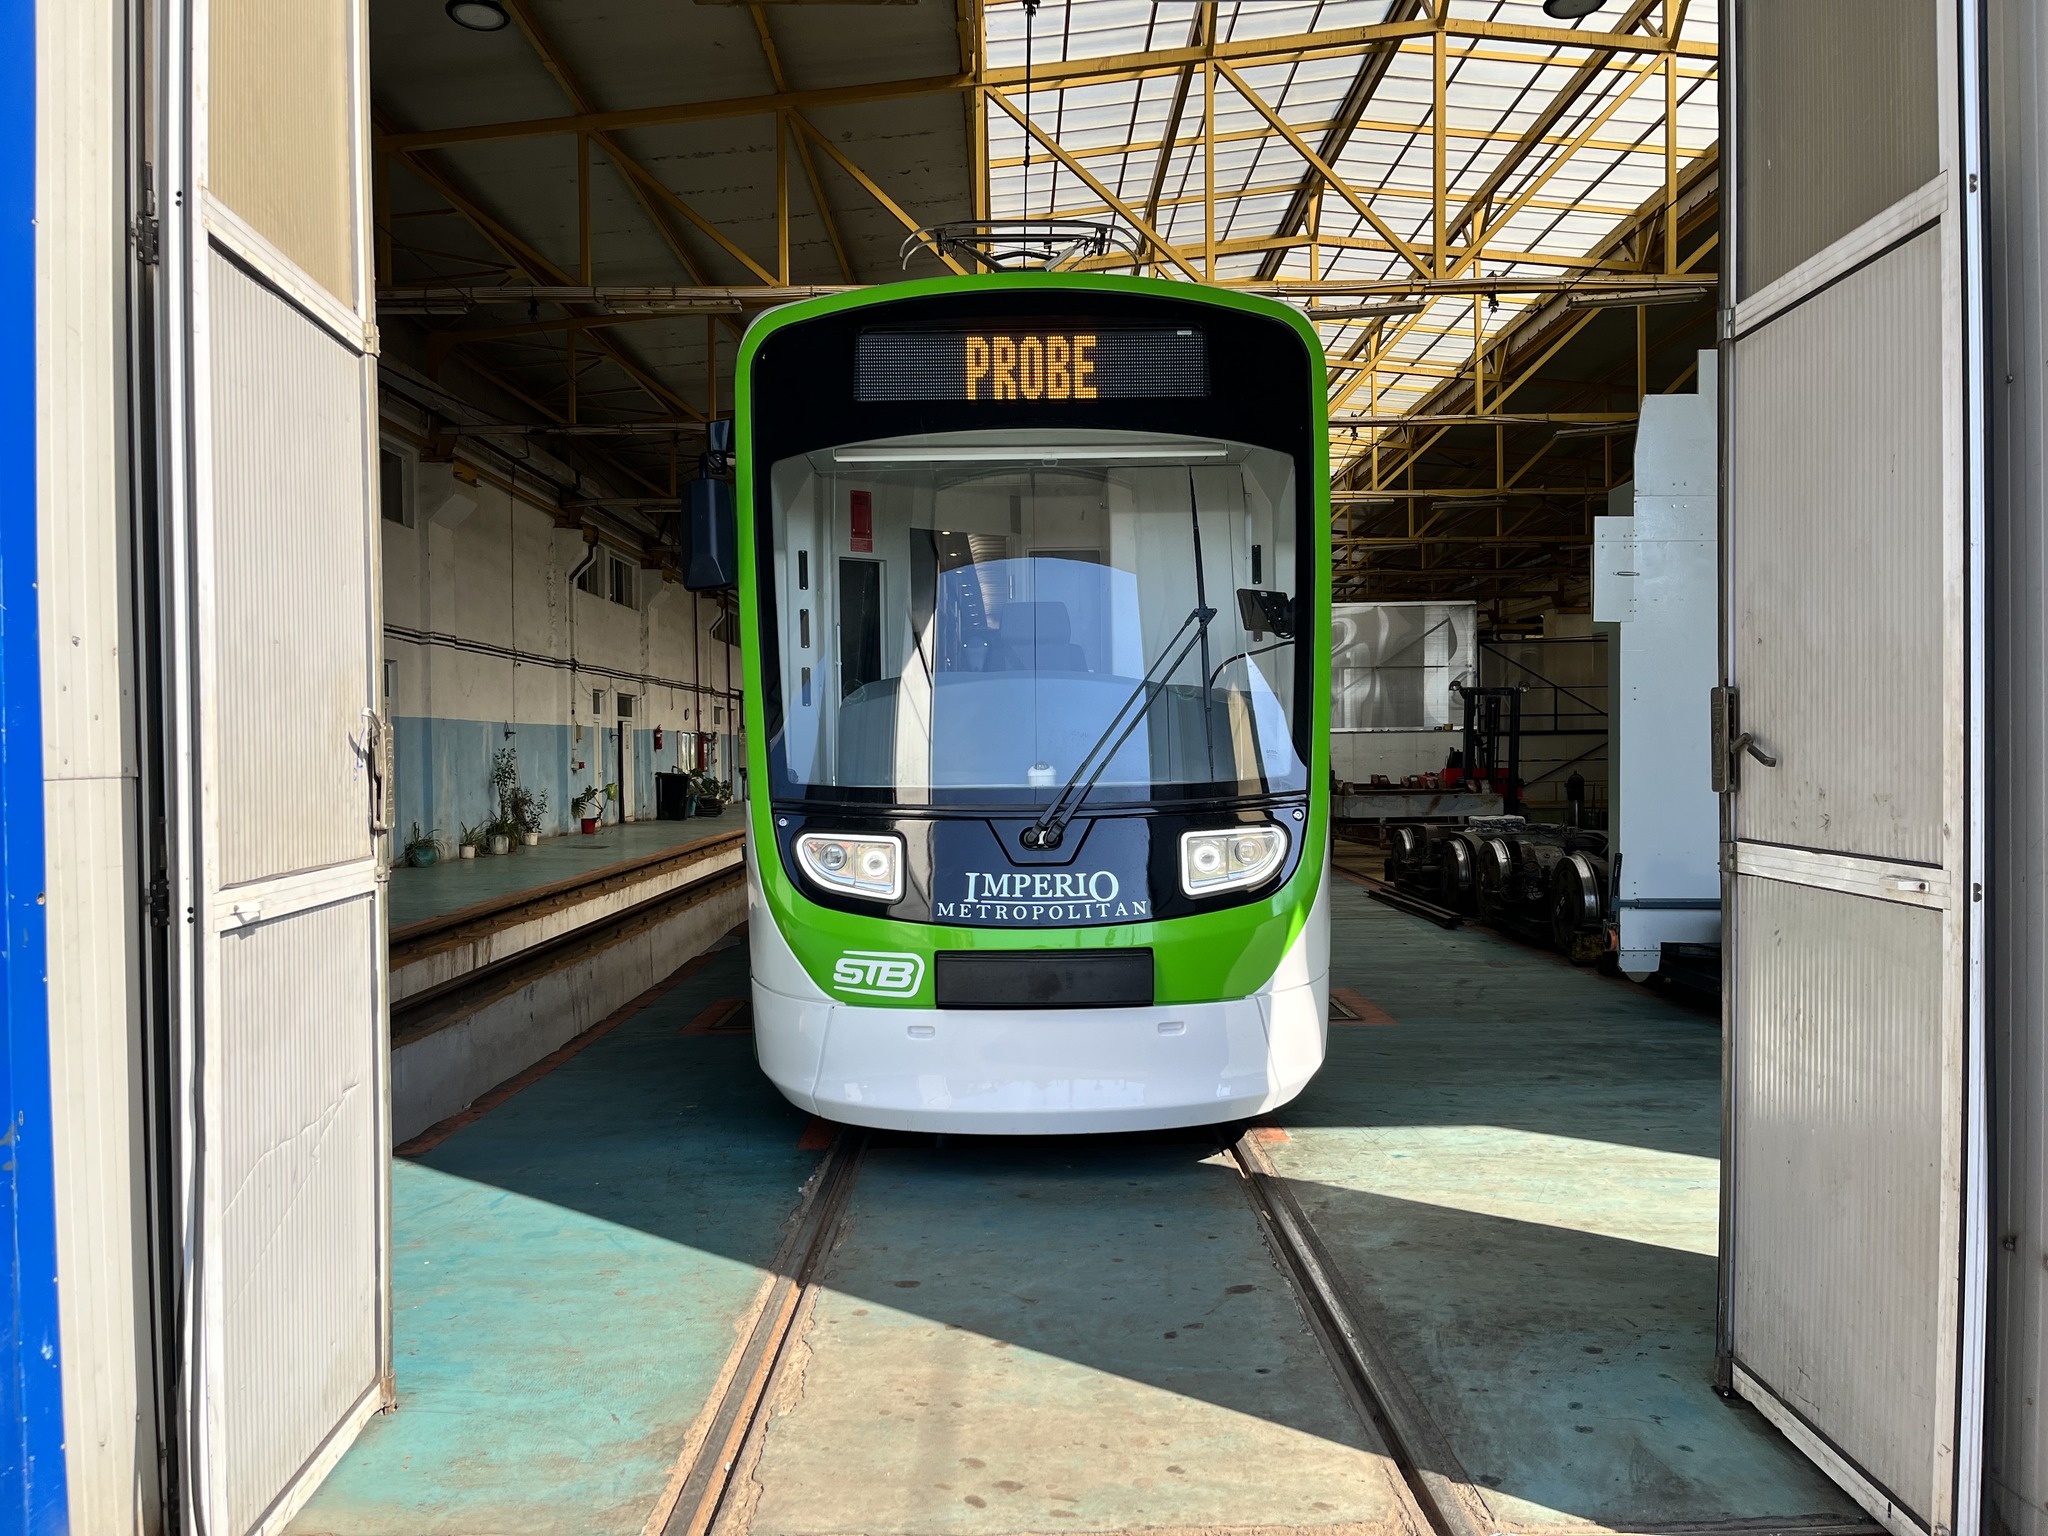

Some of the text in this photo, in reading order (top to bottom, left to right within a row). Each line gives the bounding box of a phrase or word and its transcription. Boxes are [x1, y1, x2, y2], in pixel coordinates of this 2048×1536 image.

[966, 335, 1098, 400] PROBE
[963, 870, 1120, 903] IMPERIO
[937, 900, 1148, 921] METROPOLITAN
[833, 957, 915, 989] STB
